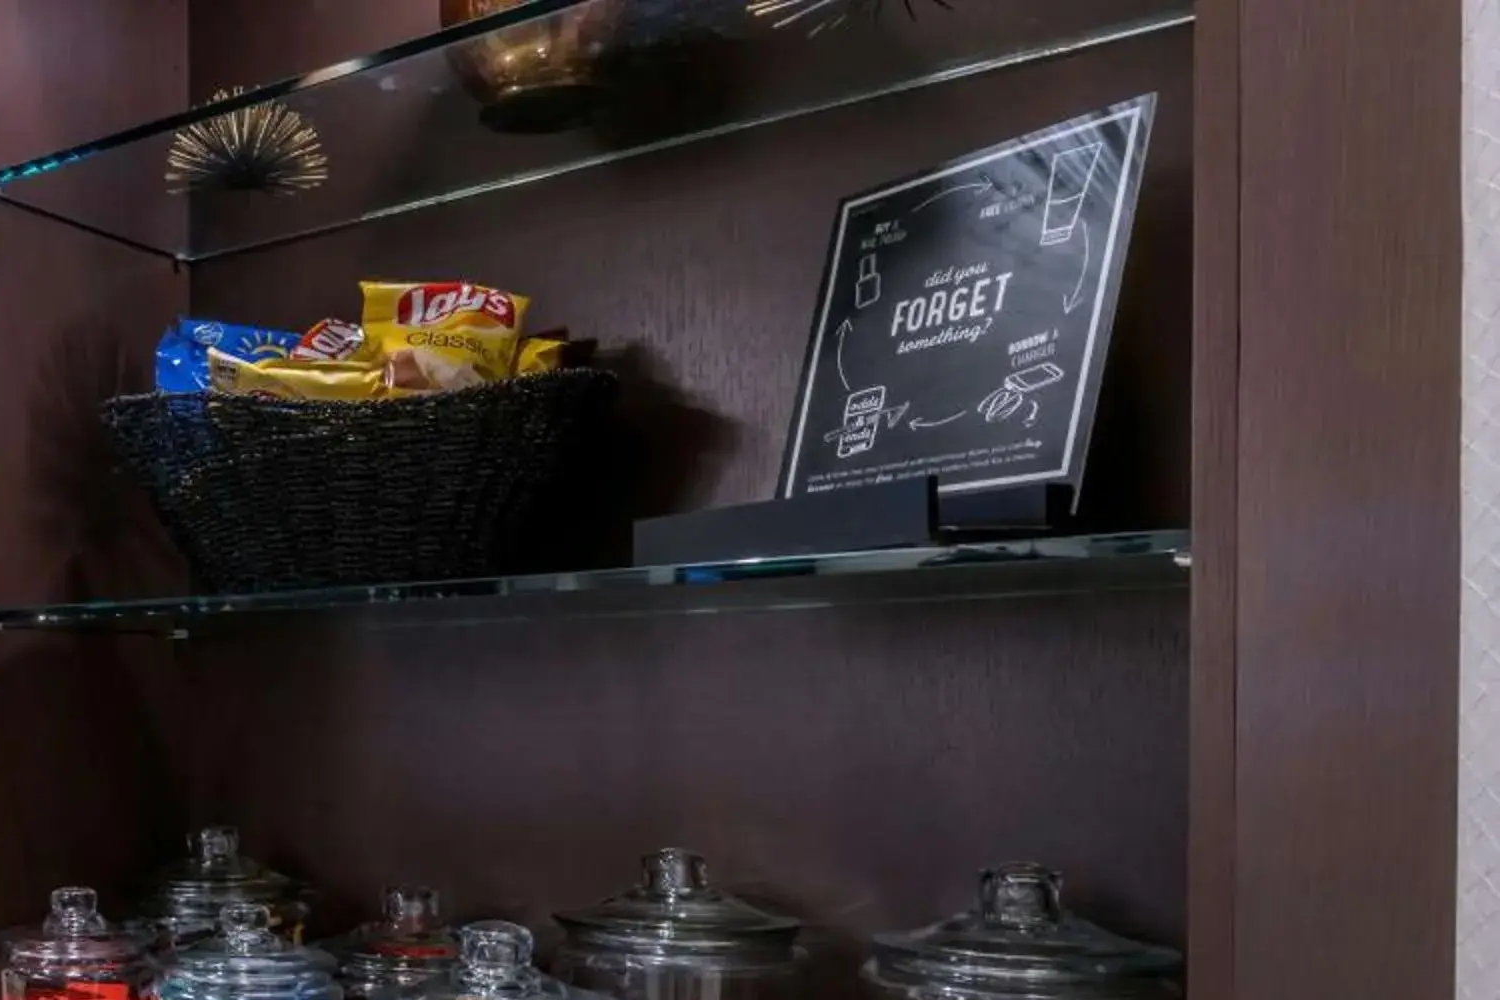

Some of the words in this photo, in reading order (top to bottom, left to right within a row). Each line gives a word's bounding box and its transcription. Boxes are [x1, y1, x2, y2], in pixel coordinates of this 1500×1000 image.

[924, 266, 954, 288] did
[954, 262, 988, 285] you
[409, 284, 509, 328] Lay's
[891, 271, 1013, 337] FORGET
[290, 317, 364, 360] Lay
[405, 330, 501, 362] Classic
[896, 316, 993, 354] something?
